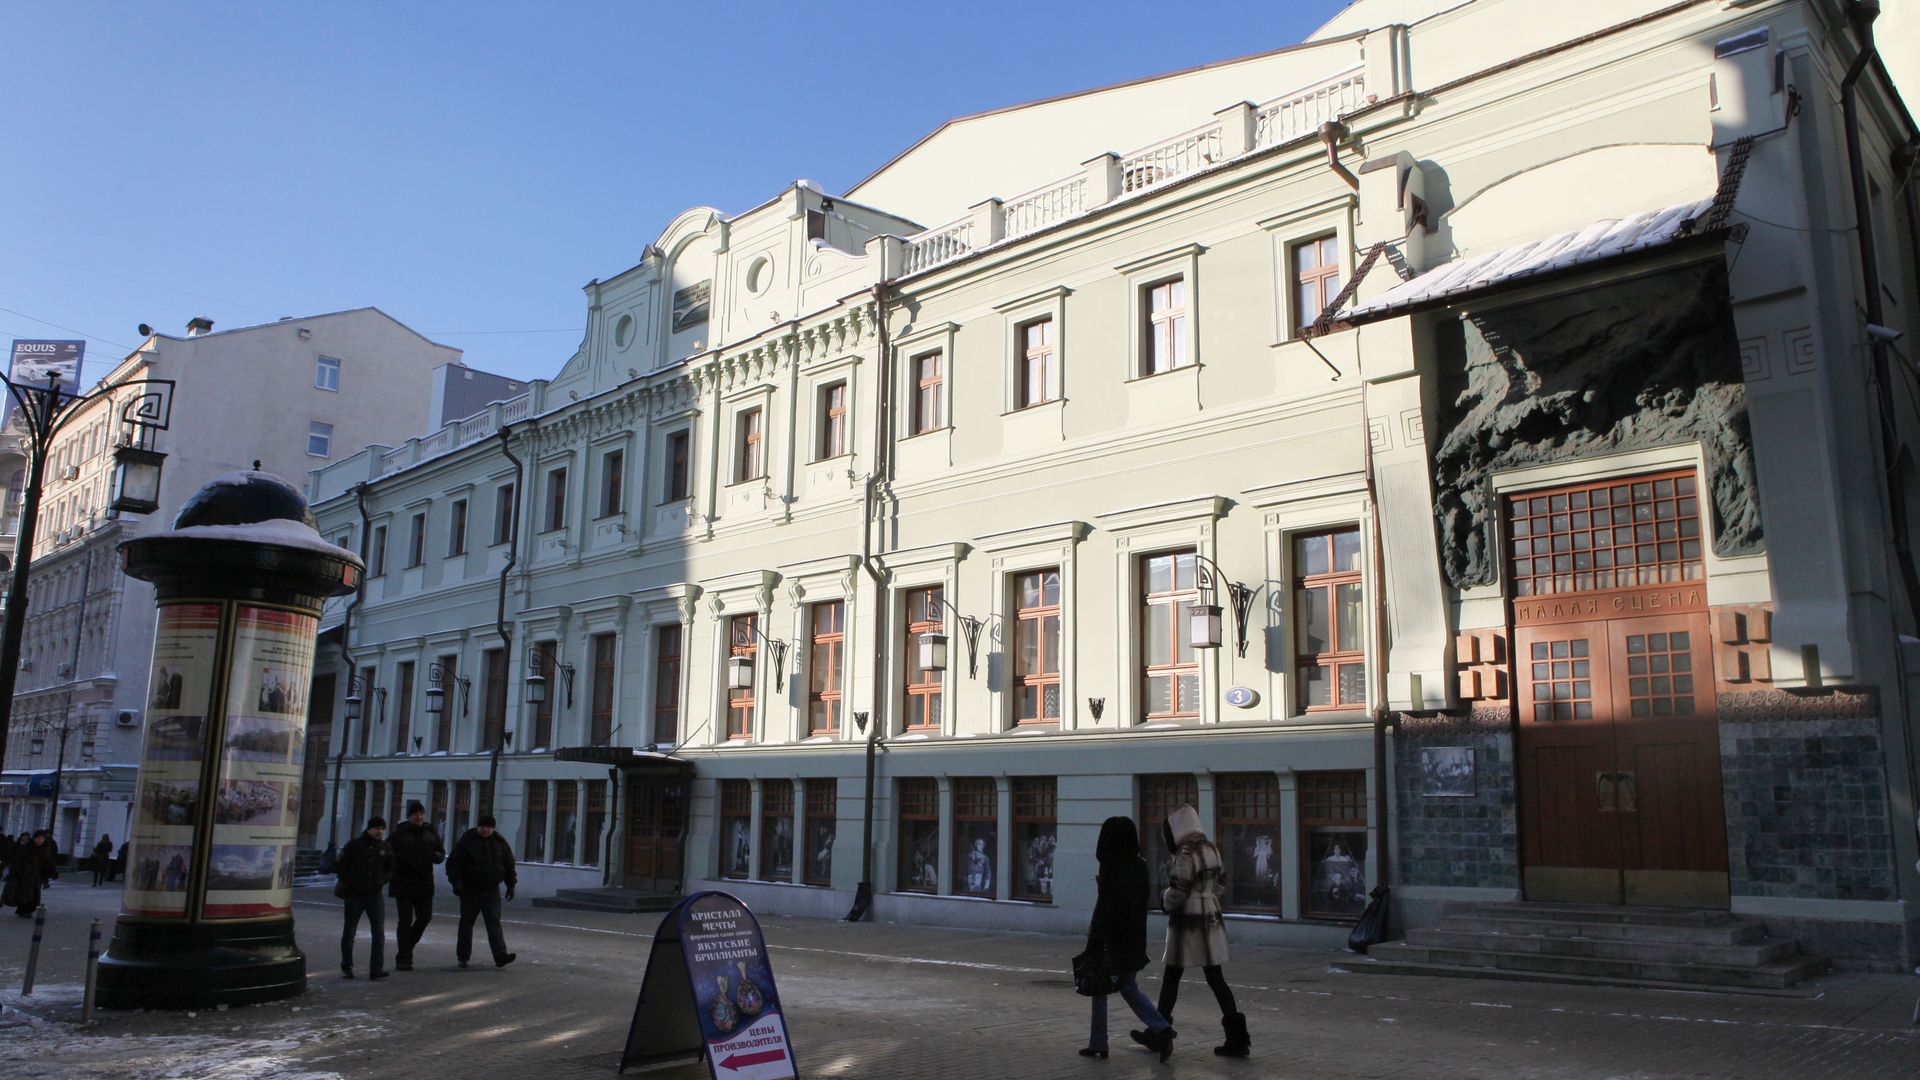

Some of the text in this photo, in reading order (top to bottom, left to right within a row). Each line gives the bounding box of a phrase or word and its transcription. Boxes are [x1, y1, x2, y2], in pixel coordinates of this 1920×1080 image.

[16, 344, 56, 352] EQUUS
[1518, 590, 1702, 620] МАЛАЯ СЦЕНА
[1234, 690, 1242, 703] 3
[691, 910, 741, 920] КРИСТАЛЛ
[702, 921, 736, 931] МЕЧТЫ
[697, 939, 750, 951] ЯКУТСКИЕ
[694, 949, 757, 961] БРИЛЛИАНТЫ
[749, 1026, 775, 1037] ЦЕНЫ
[713, 1035, 782, 1053] ПРОИЗВОДИТЕЛЯ
